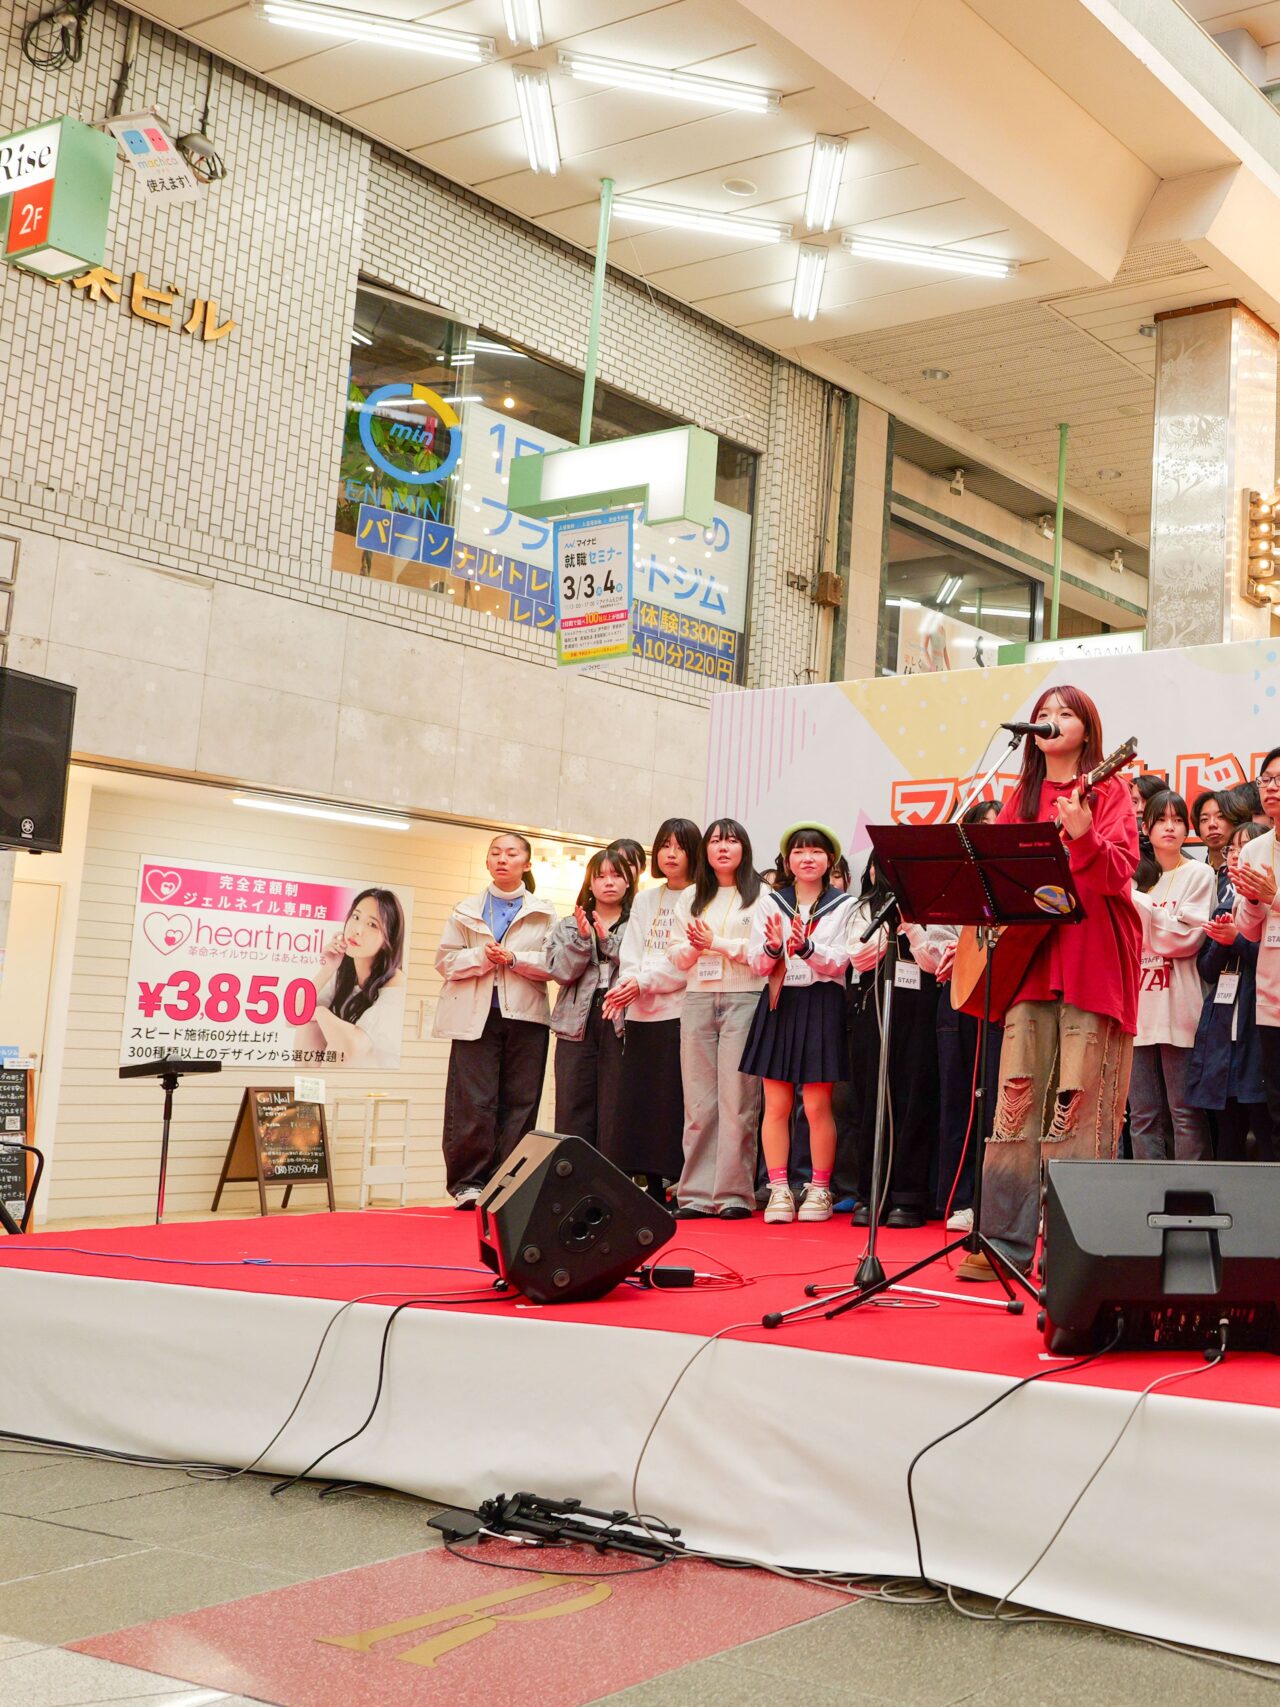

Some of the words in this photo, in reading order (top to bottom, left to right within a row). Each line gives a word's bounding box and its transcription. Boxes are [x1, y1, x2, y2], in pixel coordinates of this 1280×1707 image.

[0, 142, 52, 183] Rise
[19, 203, 43, 235] 2F
[389, 421, 433, 446] min
[576, 537, 597, 547] マイナビ
[564, 547, 623, 569] 就職セミナー
[219, 875, 299, 897] 完全定額制
[183, 892, 328, 919] ジェルネイル専門店
[195, 918, 325, 954] heartnail
[897, 977, 917, 985] STAFF
[1216, 992, 1233, 1000] STAFF
